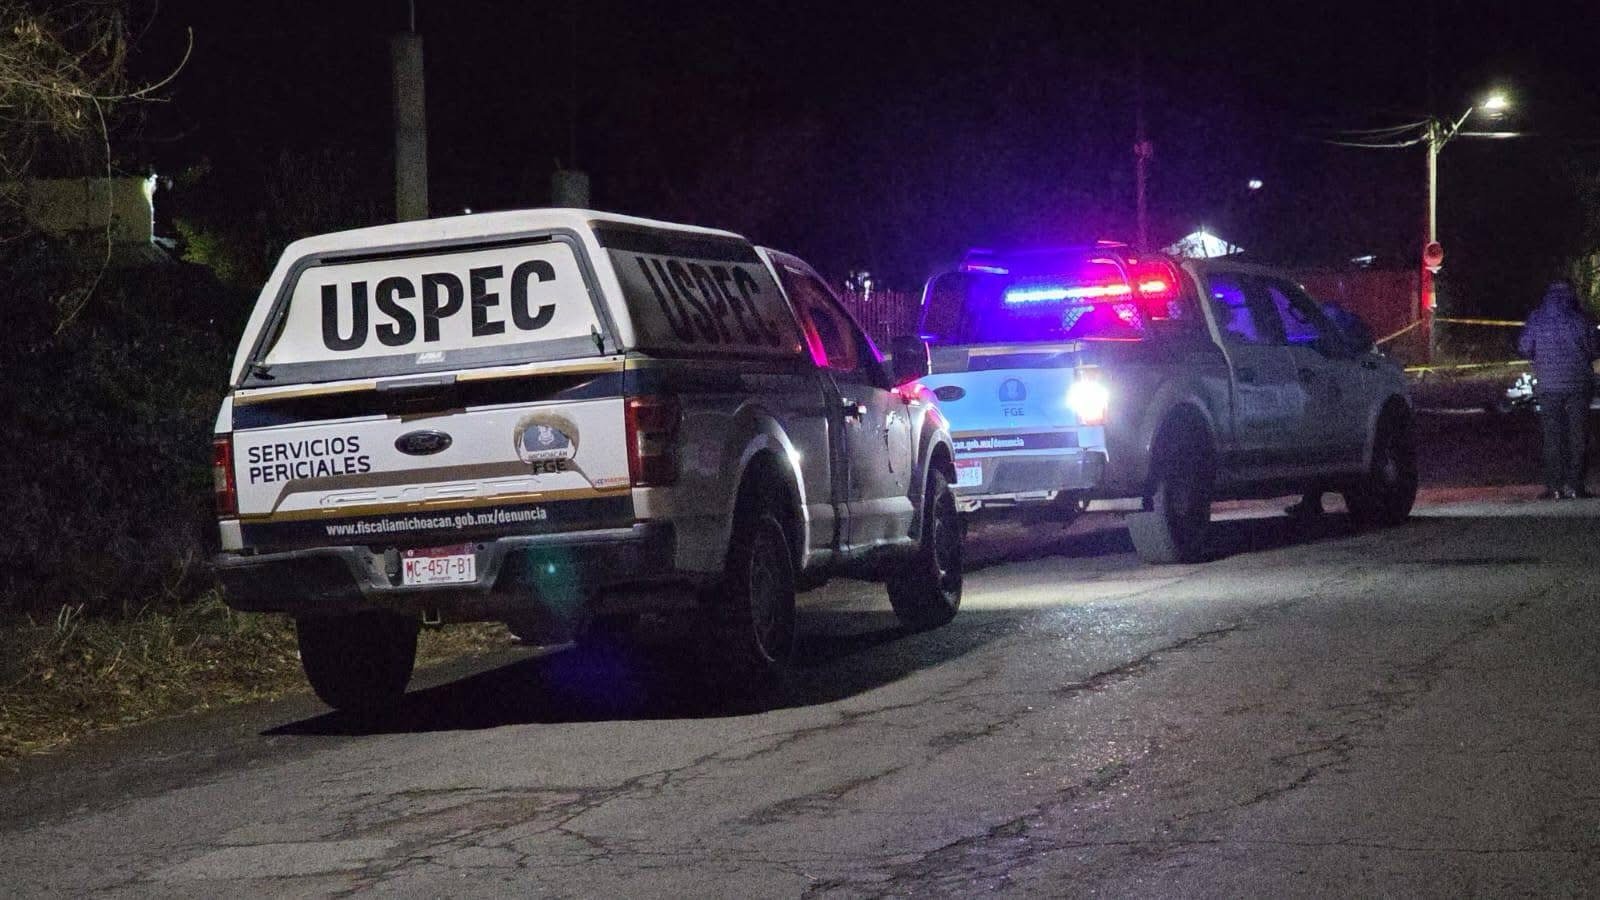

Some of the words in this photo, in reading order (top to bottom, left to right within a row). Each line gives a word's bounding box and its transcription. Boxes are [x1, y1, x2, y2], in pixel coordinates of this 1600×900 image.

[321, 259, 557, 351] USPEC
[635, 256, 781, 347] USPEC
[1004, 408, 1024, 416] FGE
[248, 436, 360, 464] SERVICIOS
[250, 455, 371, 484] PERICIALES
[532, 459, 566, 475] FGE
[326, 507, 547, 536] www.fiscaliamichoacan.gob.mx/denuncia
[406, 557, 472, 578] MC-457-B1
